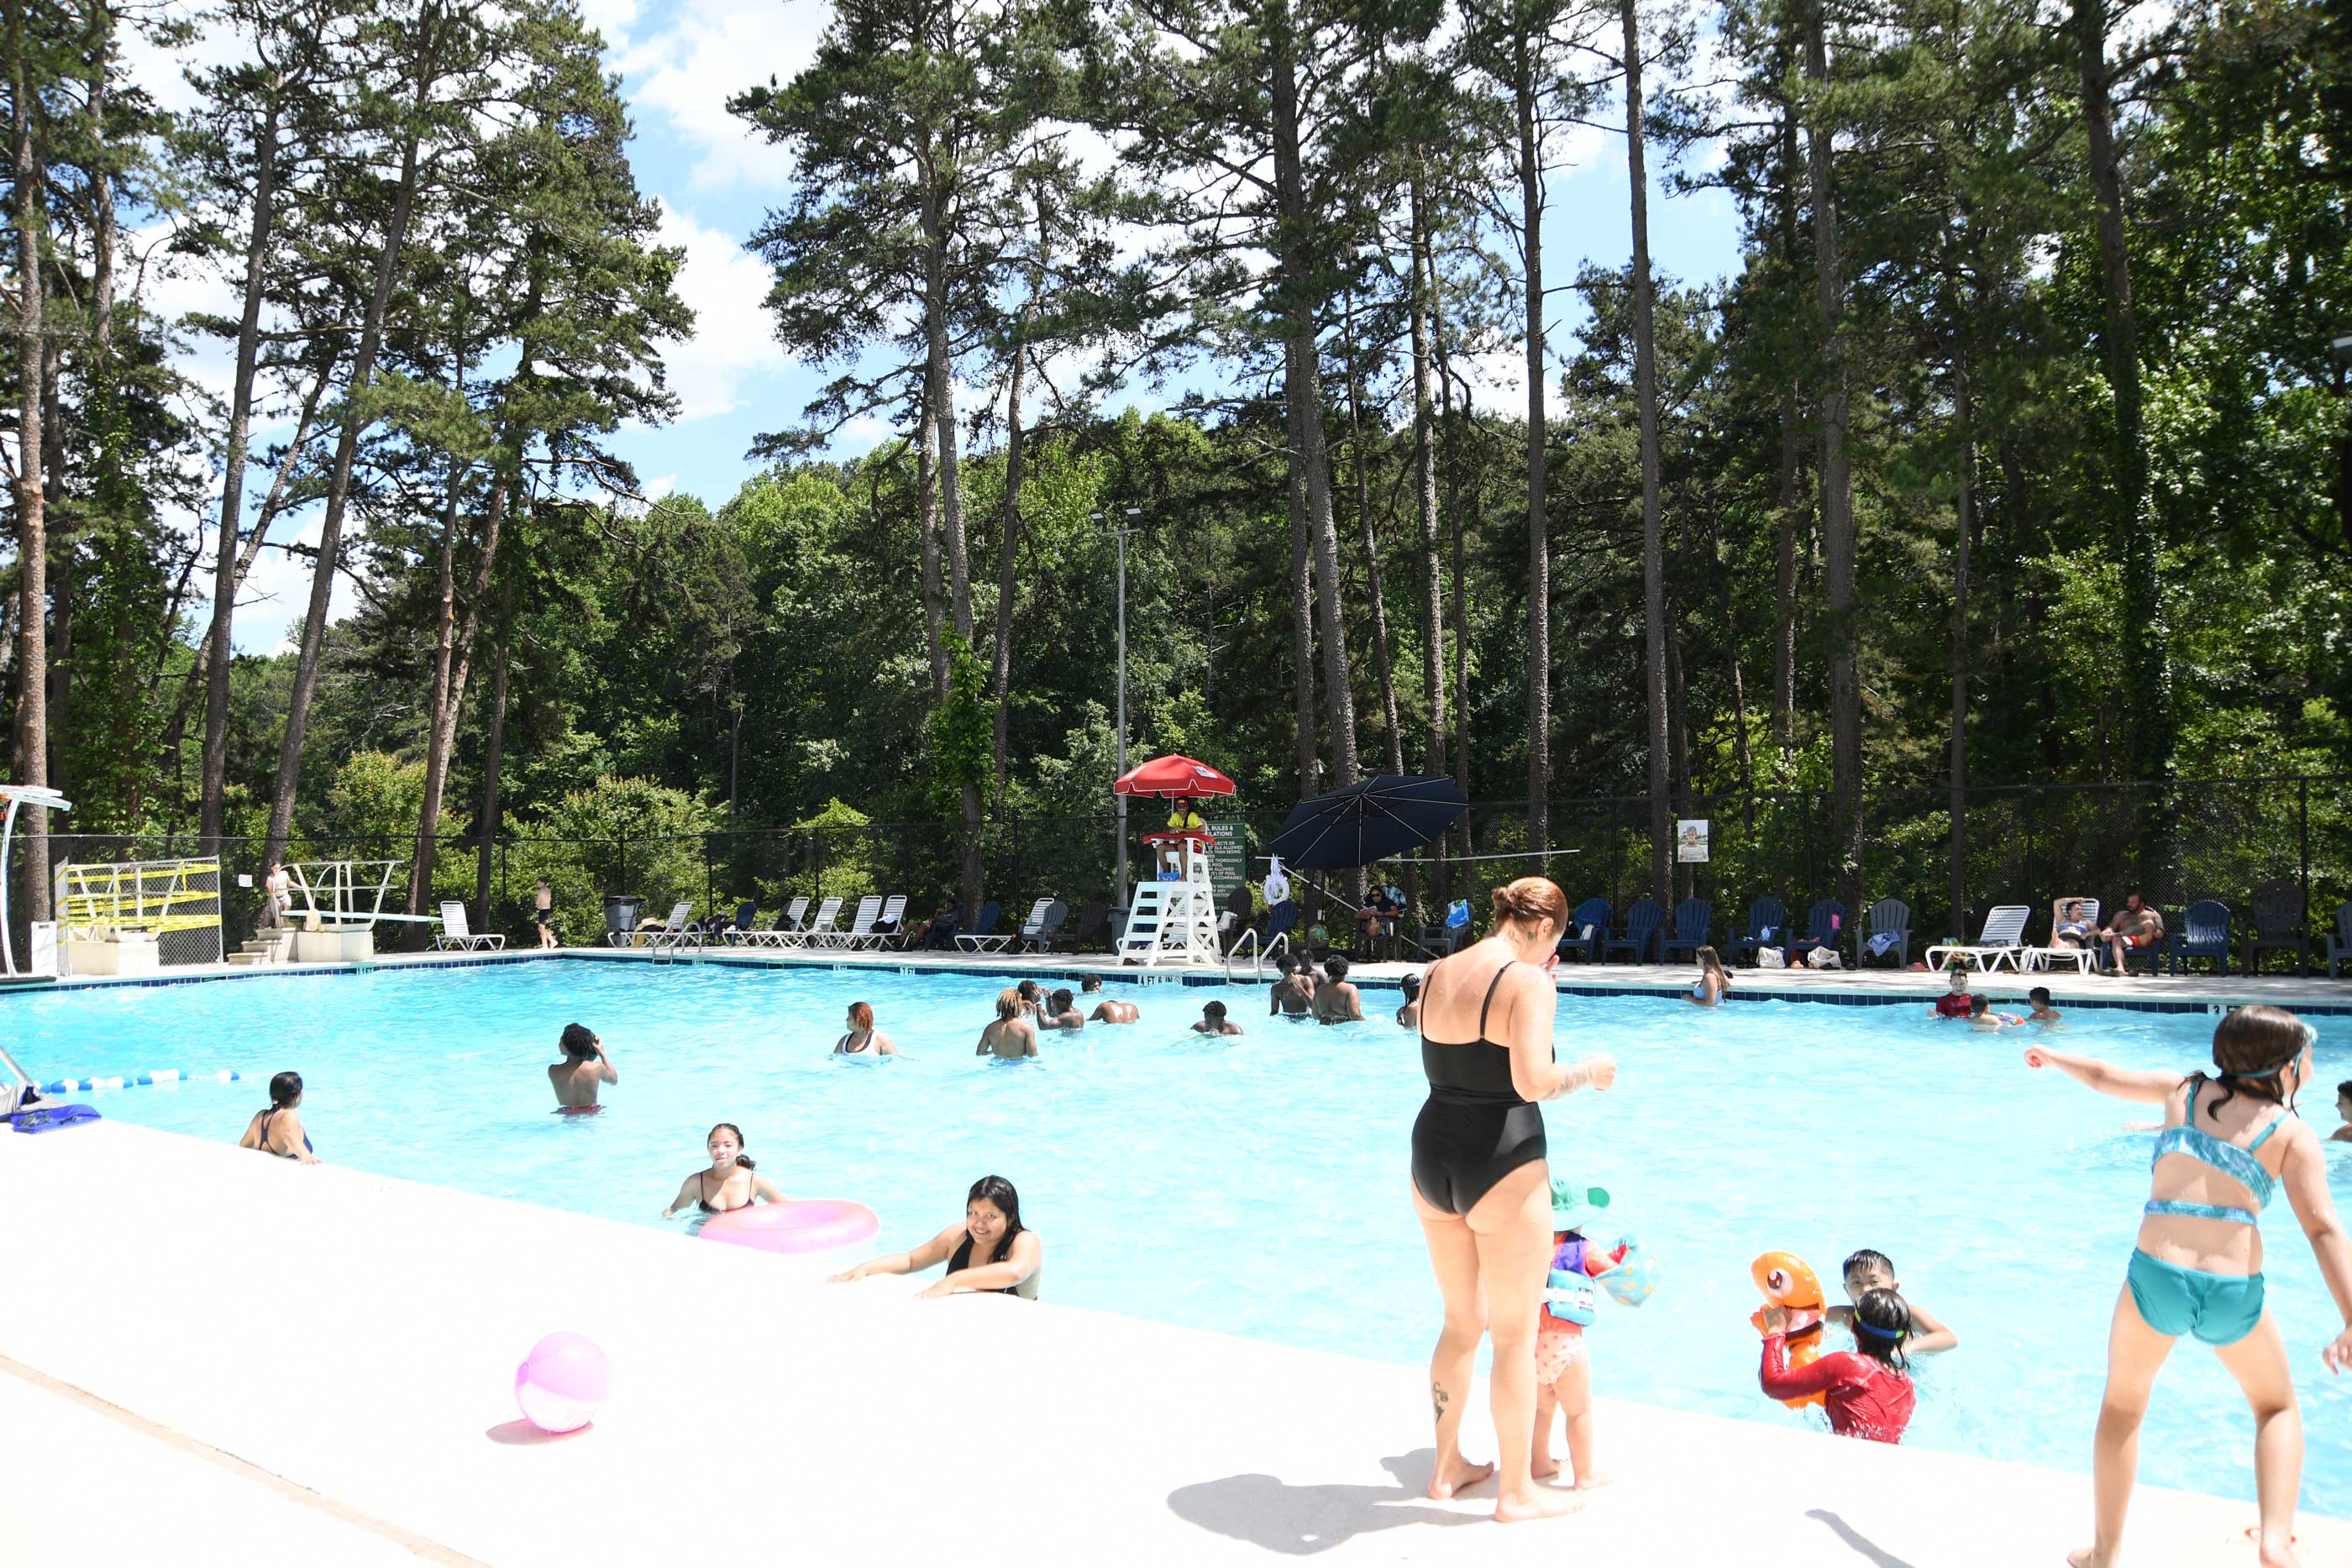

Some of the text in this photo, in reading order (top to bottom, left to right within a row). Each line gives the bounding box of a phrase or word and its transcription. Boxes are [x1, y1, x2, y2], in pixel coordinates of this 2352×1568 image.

[1141, 975, 1145, 986] 4
[1147, 976, 1155, 985] FT
[2213, 1004, 2220, 1015] 3
